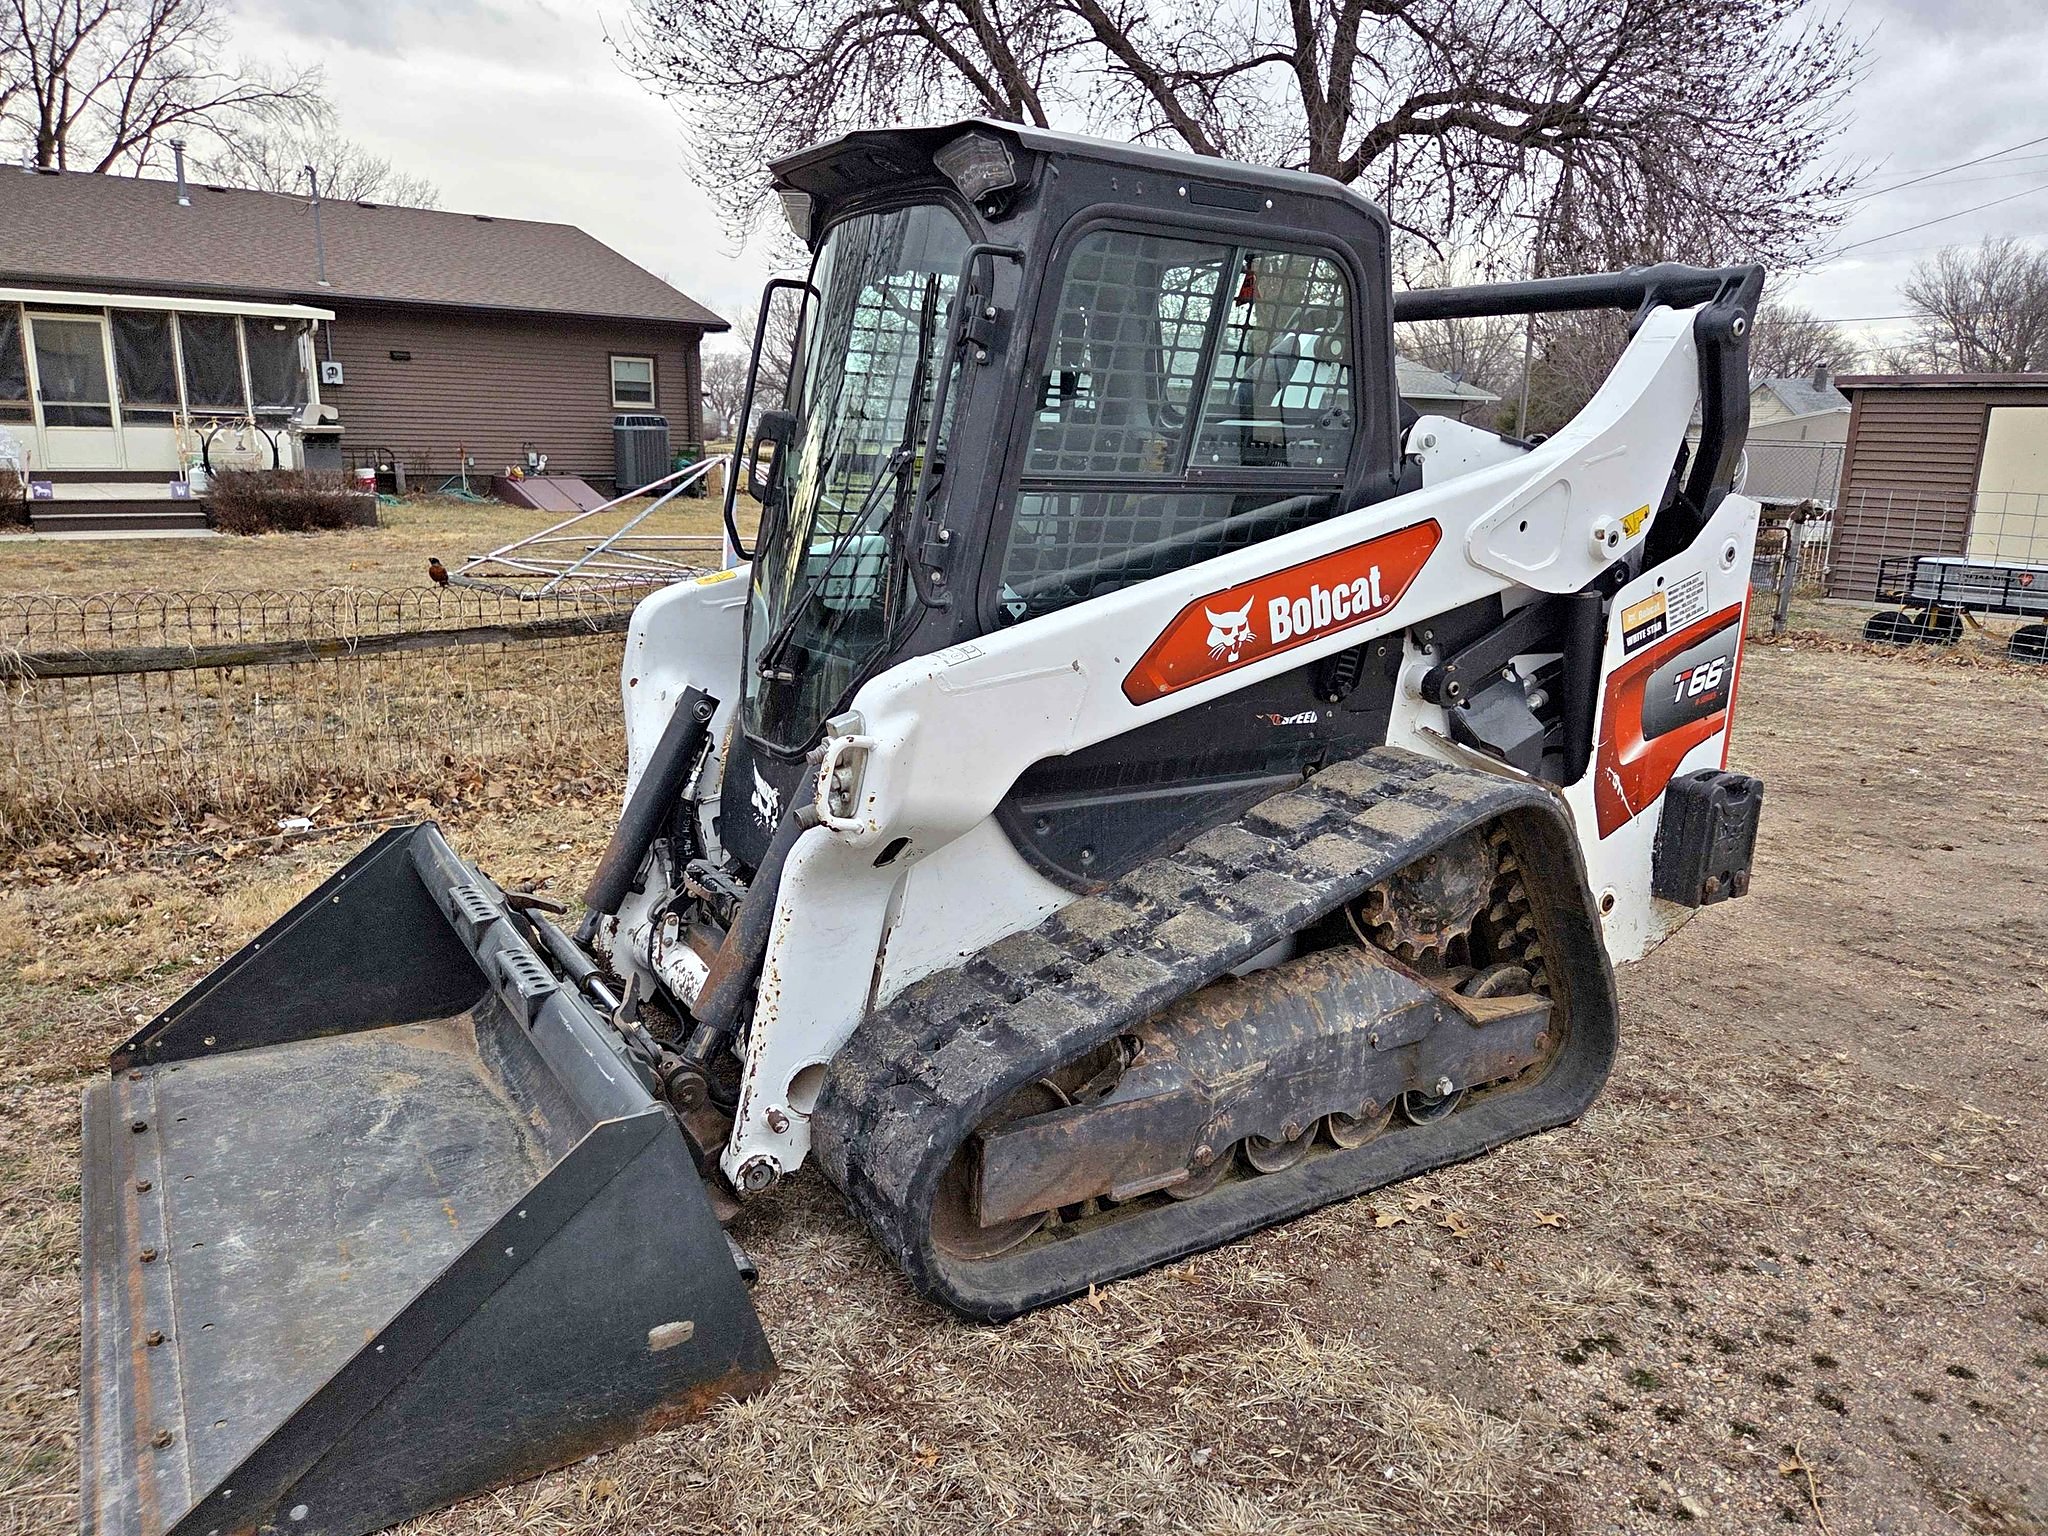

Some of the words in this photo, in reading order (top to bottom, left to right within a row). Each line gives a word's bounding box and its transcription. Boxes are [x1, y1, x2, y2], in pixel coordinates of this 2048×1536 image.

[175, 486, 186, 496] W
[1267, 565, 1383, 644] Bobcat
[1638, 600, 1661, 621] Bobcat
[1626, 627, 1647, 647] WHITE
[1646, 621, 1662, 637] STAR
[1673, 655, 1727, 704] T66
